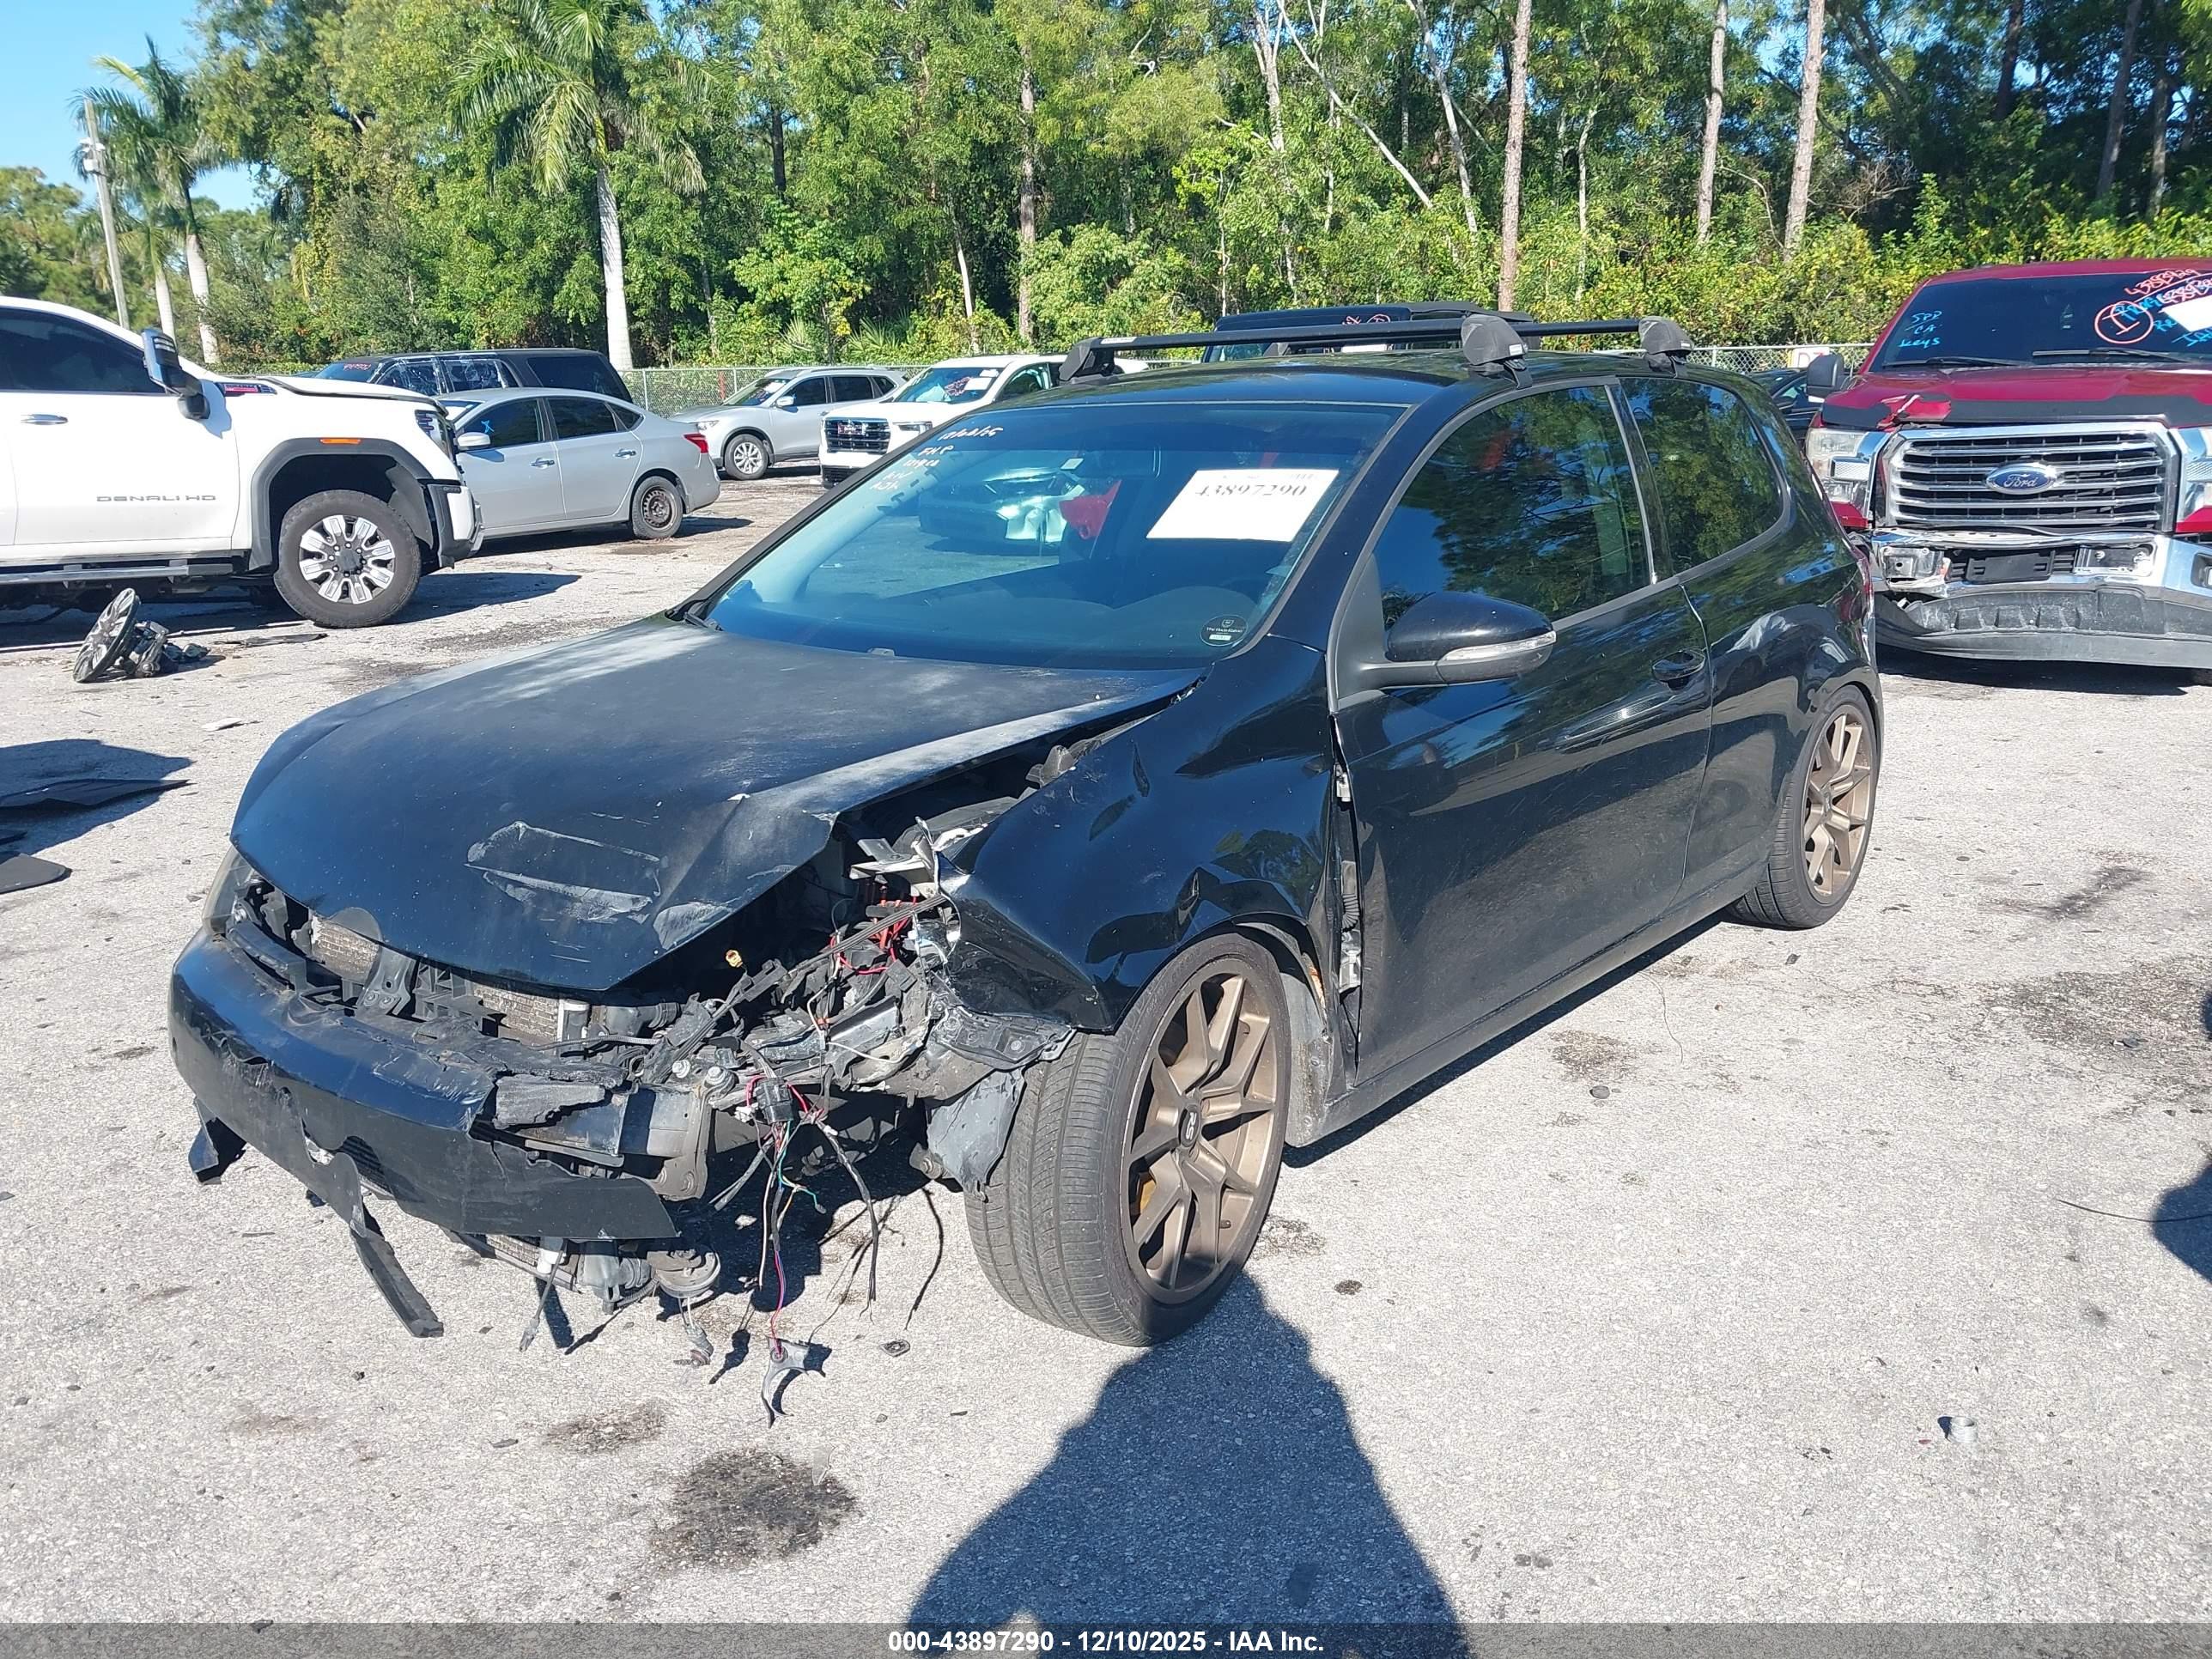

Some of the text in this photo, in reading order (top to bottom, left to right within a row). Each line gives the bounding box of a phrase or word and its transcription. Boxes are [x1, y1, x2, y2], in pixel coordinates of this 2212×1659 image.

[2003, 474, 2039, 488] Ford
[1195, 484, 1307, 496] 43897290
[1185, 1112, 1197, 1140] RS
